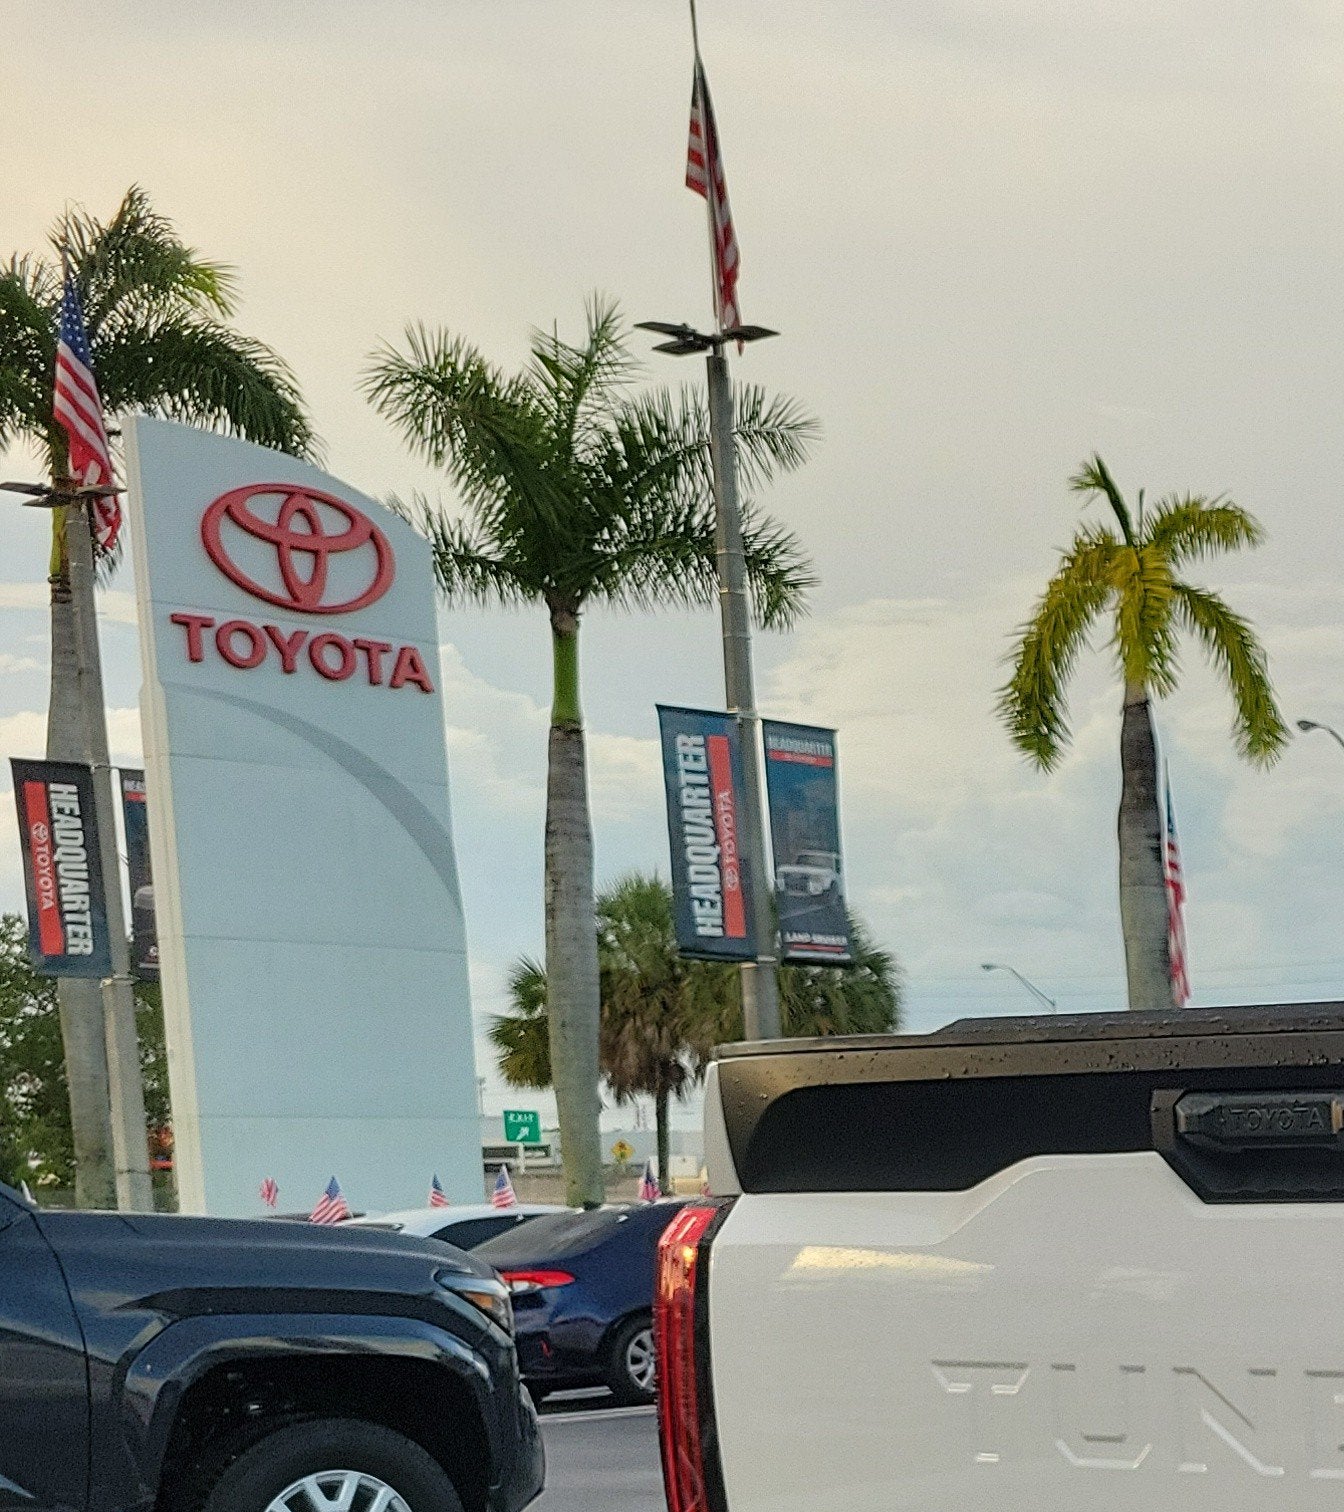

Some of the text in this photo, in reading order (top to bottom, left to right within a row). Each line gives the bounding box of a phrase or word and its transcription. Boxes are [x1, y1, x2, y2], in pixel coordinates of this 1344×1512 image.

[170, 612, 435, 693] TOYOTA
[49, 782, 94, 956] HEADQUARTER
[676, 734, 725, 938] HEADQUARTER
[35, 845, 56, 910] TOYOTA
[1230, 1106, 1325, 1131] TOYOTA
